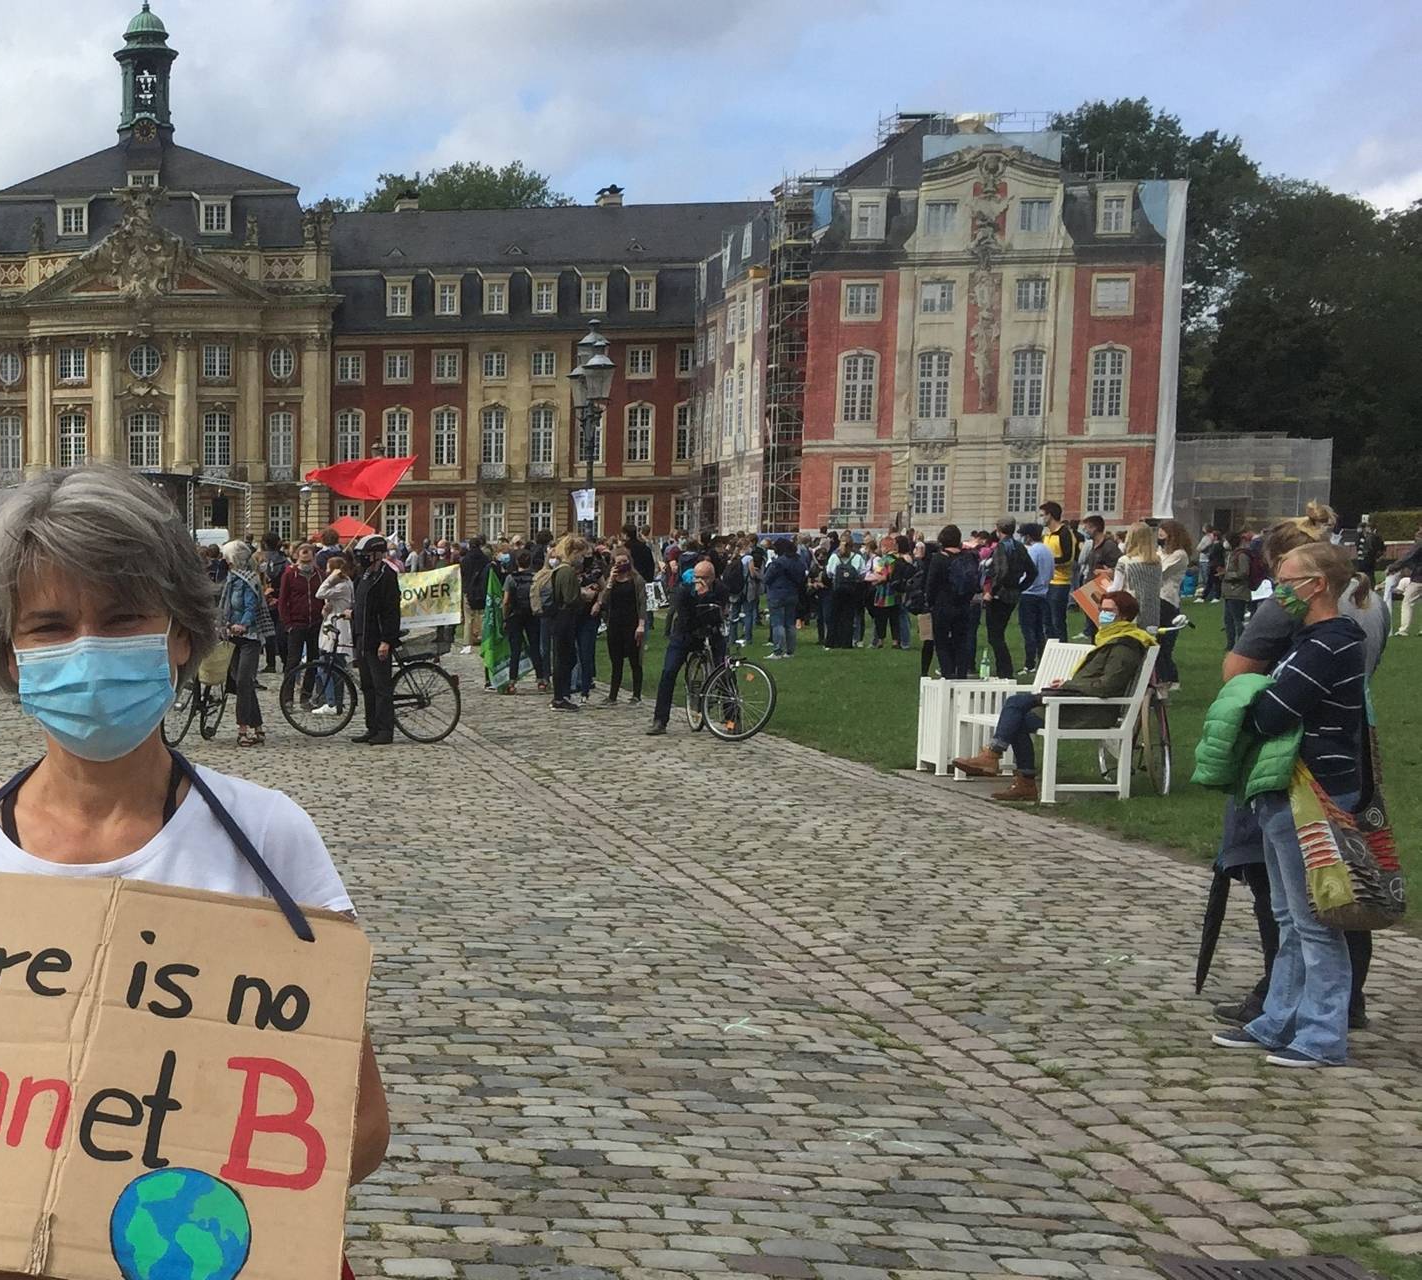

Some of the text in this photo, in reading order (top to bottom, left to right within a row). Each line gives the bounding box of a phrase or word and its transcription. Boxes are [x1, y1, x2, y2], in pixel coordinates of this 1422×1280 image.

[400, 582, 451, 601] OWER
[126, 931, 200, 1019] is
[227, 974, 310, 1032] no
[220, 1056, 327, 1191] B
